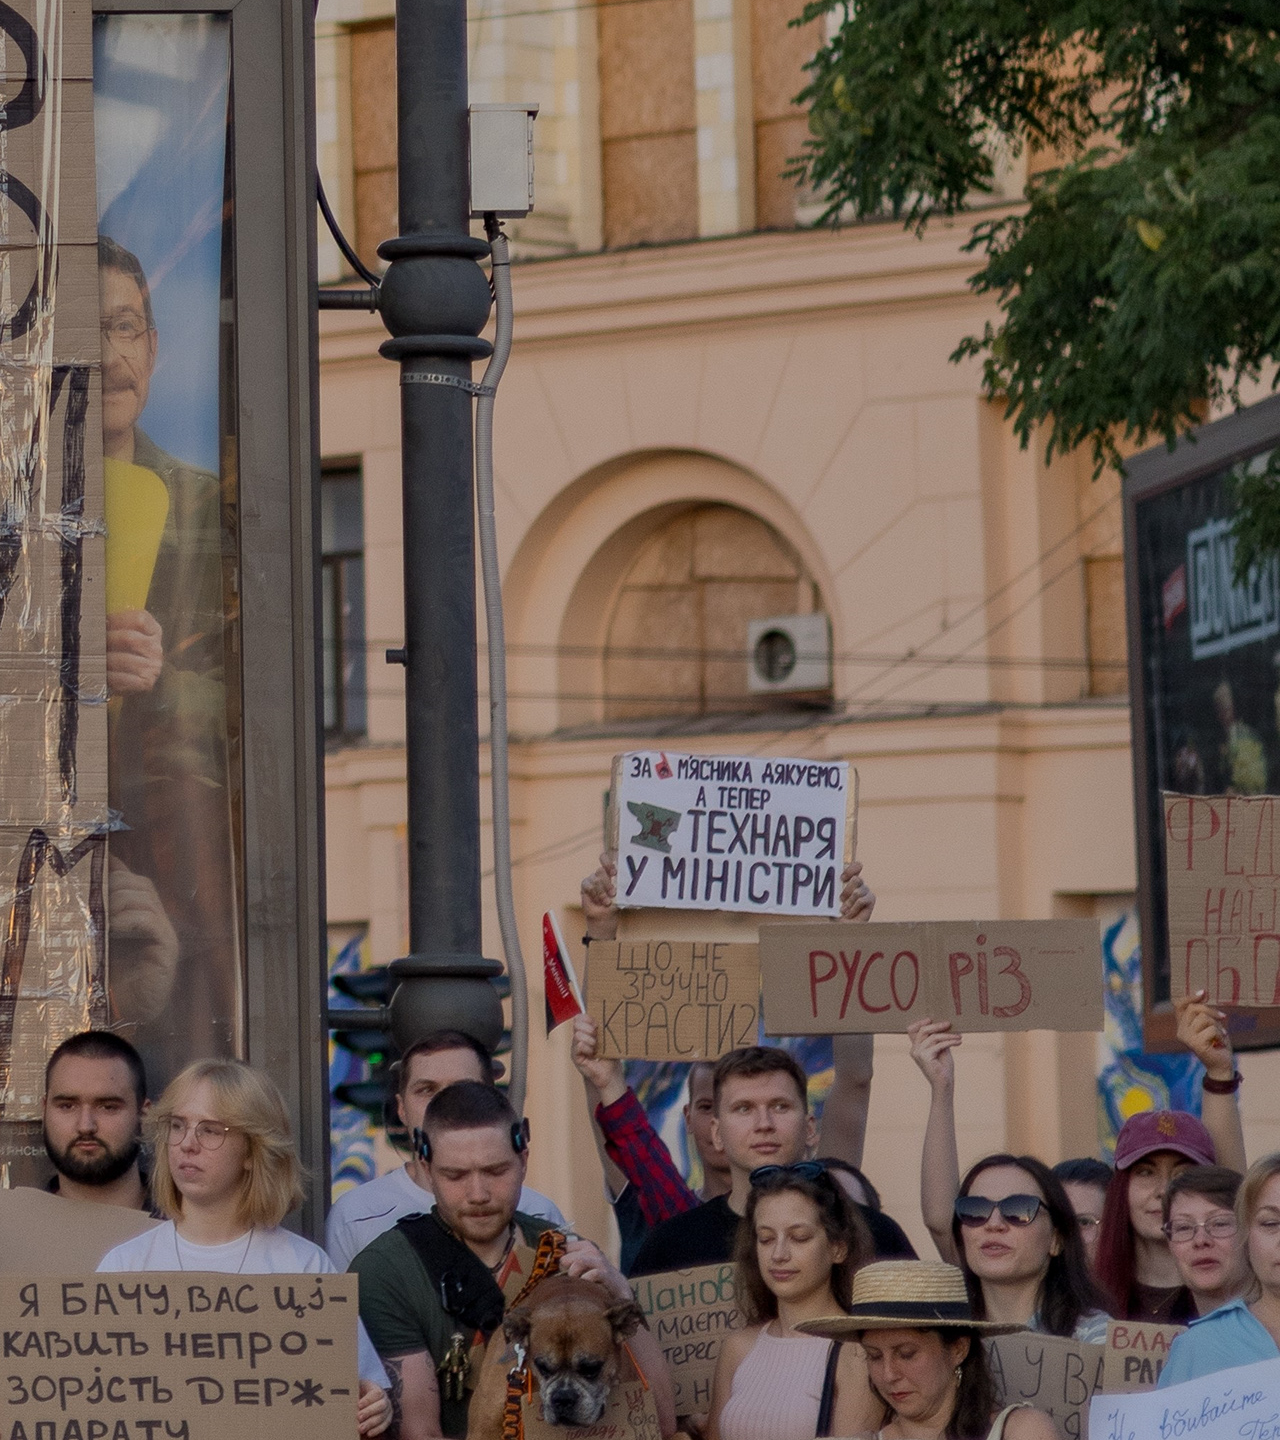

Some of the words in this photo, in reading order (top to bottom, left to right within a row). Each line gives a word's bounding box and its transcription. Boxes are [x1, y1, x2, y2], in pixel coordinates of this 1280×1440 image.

[630, 757, 652, 779] ЗА
[761, 761, 844, 791] ДЯКУЄМО,
[695, 785, 707, 808] А
[718, 786, 771, 810] ТЕПЕР
[687, 809, 837, 860] ТЕХНАРЯ
[625, 855, 649, 897] У
[661, 856, 836, 909] МІНІСТРИ
[692, 942, 730, 972] НЕ
[622, 971, 729, 1002] ЗРУЧНО
[809, 949, 919, 1019] РУСО
[19, 1282, 40, 1317] Я
[60, 1281, 181, 1320] БАЧУ,
[188, 1284, 259, 1314] ВАС
[3, 1330, 149, 1360] КАВИТЬ
[164, 1330, 334, 1369] НЕПРО-
[185, 1377, 351, 1408] ДЕРЖ-
[1159, 1389, 1268, 1440] вбивайте
